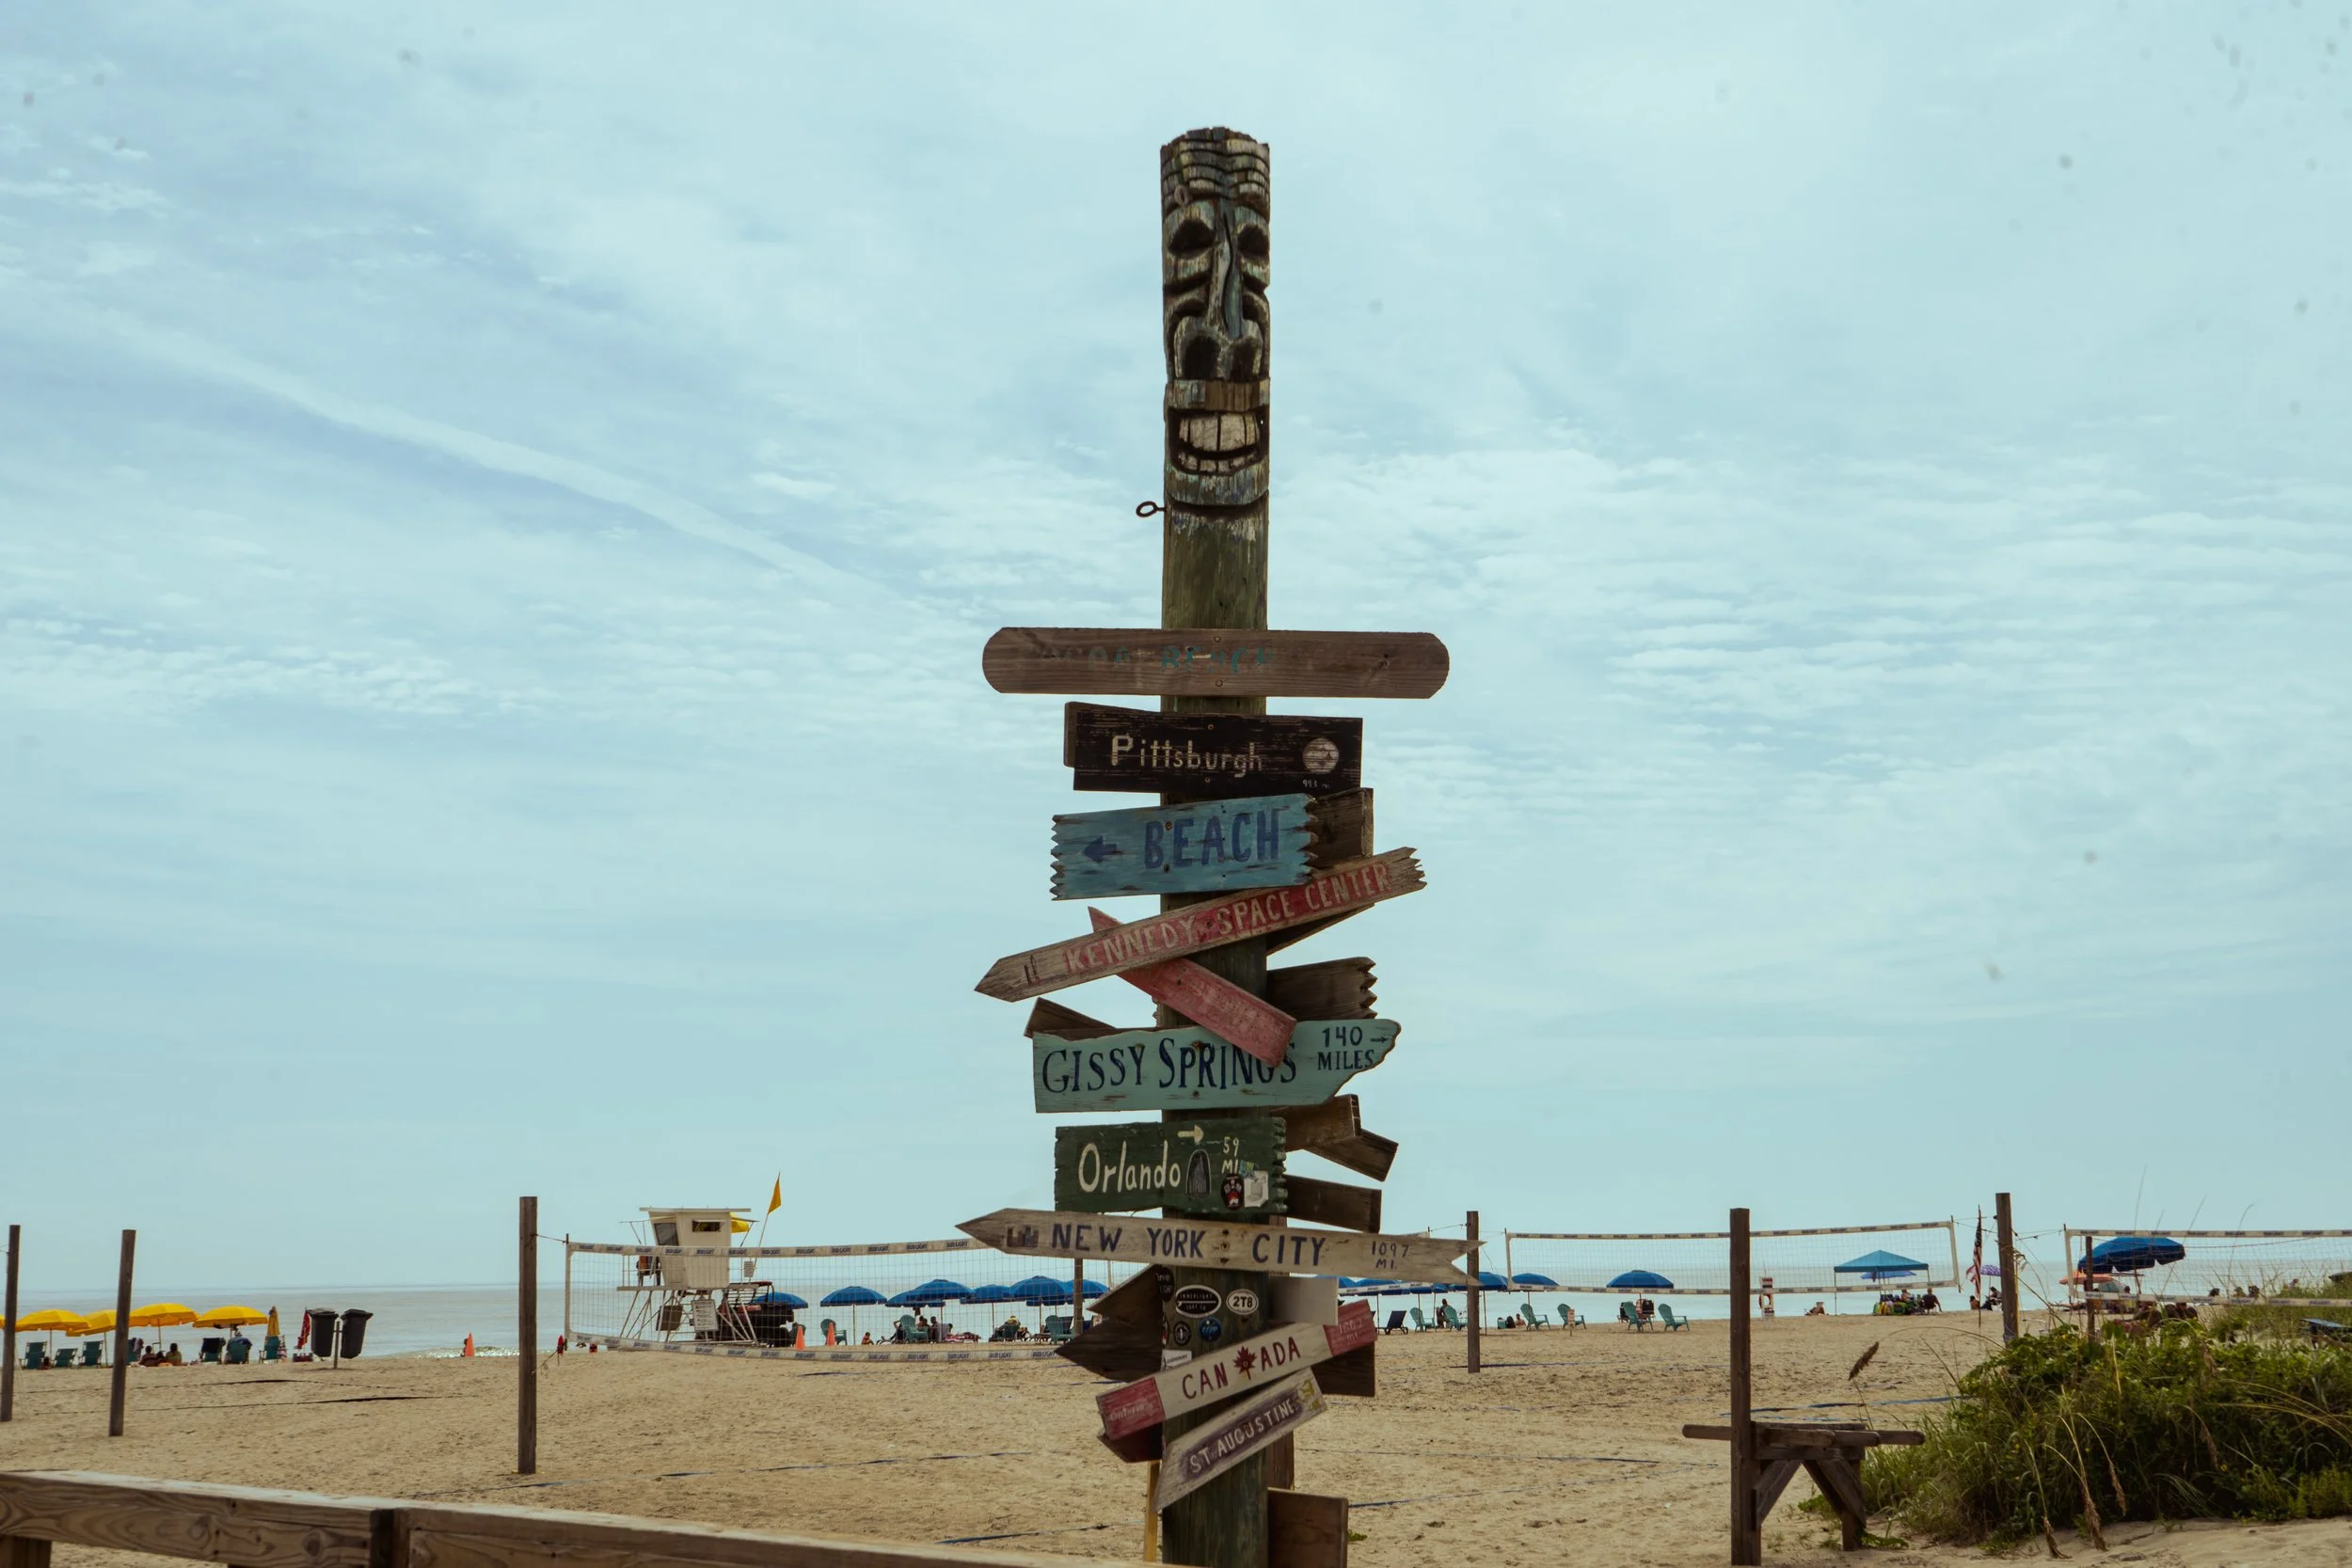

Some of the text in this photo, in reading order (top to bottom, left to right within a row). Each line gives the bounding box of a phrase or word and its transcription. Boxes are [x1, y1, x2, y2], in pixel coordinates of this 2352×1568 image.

[1110, 735, 1263, 778] Pittsburgh
[1143, 808, 1280, 869] BEACH
[1064, 863, 1393, 973] KENNEDY SPACE CENTER
[1322, 1025, 1363, 1047] 140
[1042, 1044, 1146, 1093] GISSY
[1317, 1049, 1375, 1070] MILES
[1078, 1140, 1181, 1193] Orlando
[1223, 1135, 1240, 1157] 59
[1052, 1223, 1327, 1267] NEW YORK CITY
[1371, 1240, 1411, 1259] 1097
[1232, 1296, 1253, 1307] 2T8
[1188, 1399, 1295, 1474] ST AUGUSTINE
